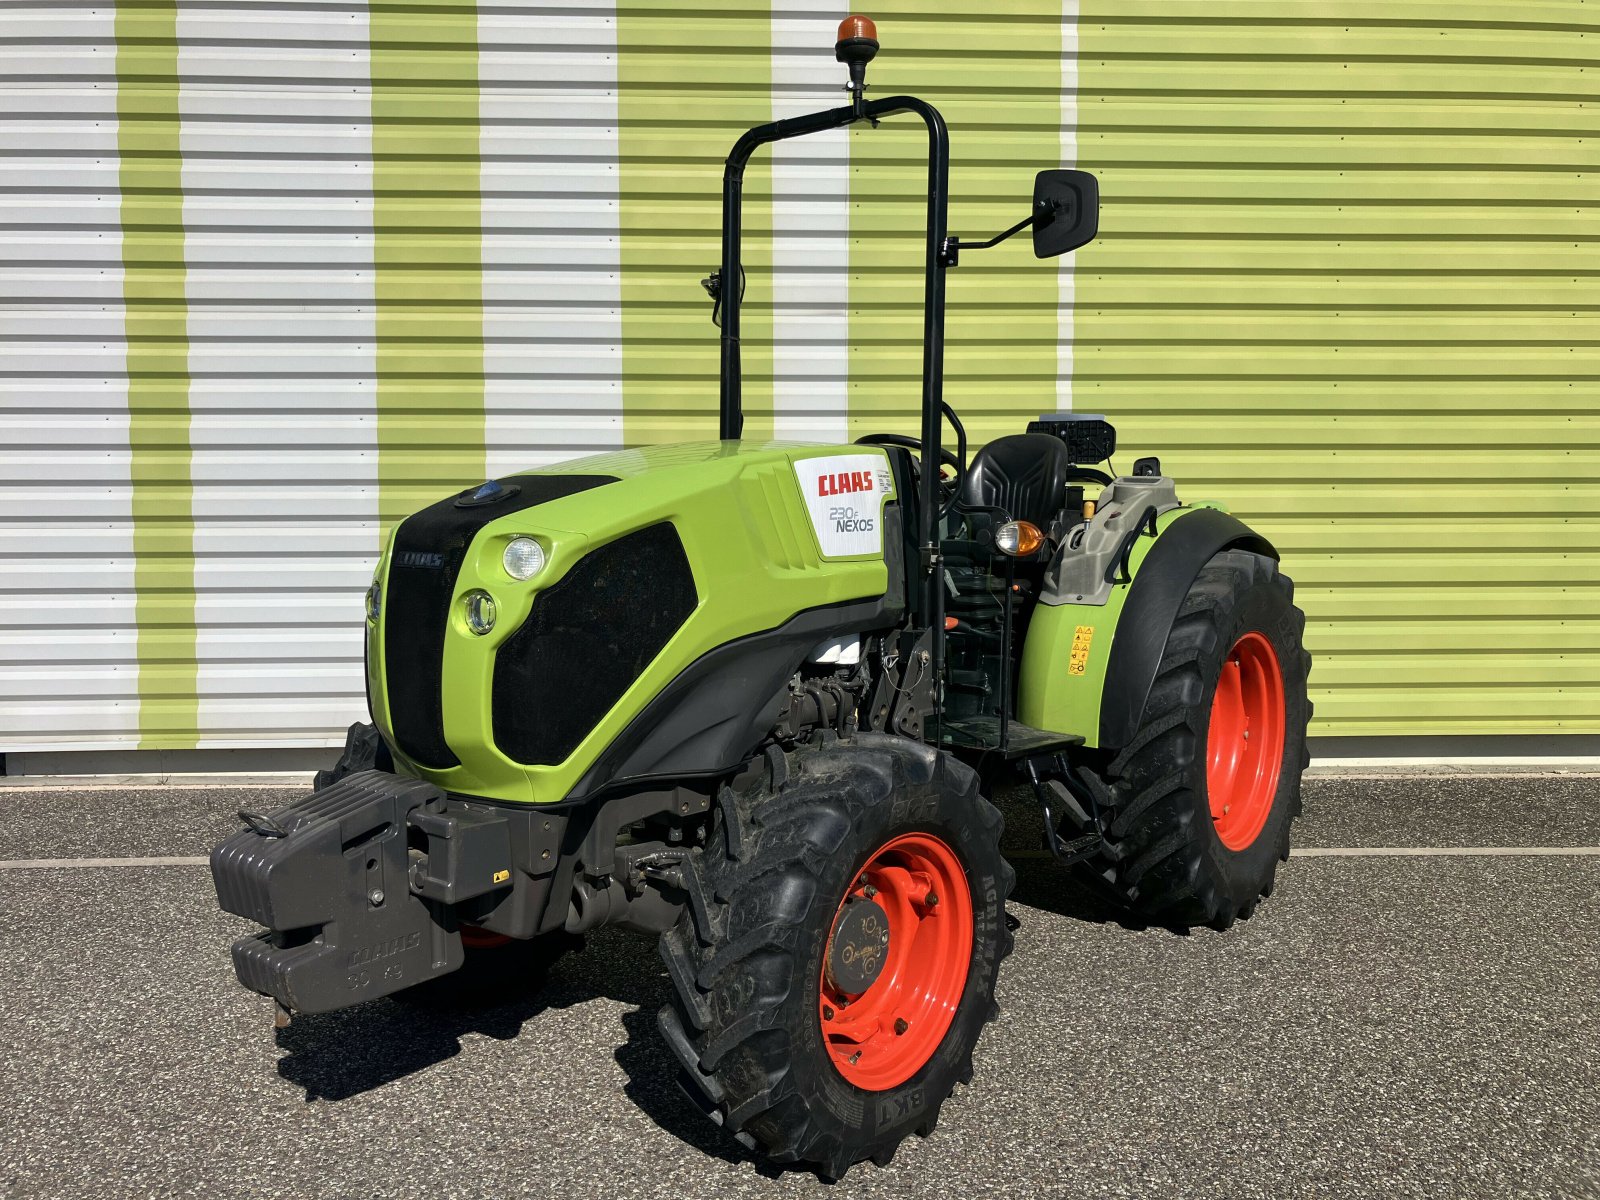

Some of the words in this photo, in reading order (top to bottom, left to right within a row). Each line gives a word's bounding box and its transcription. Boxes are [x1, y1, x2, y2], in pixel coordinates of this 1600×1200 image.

[818, 471, 873, 497] CLAAS
[836, 519, 874, 533] NEXOS
[348, 931, 421, 969] CLAAS
